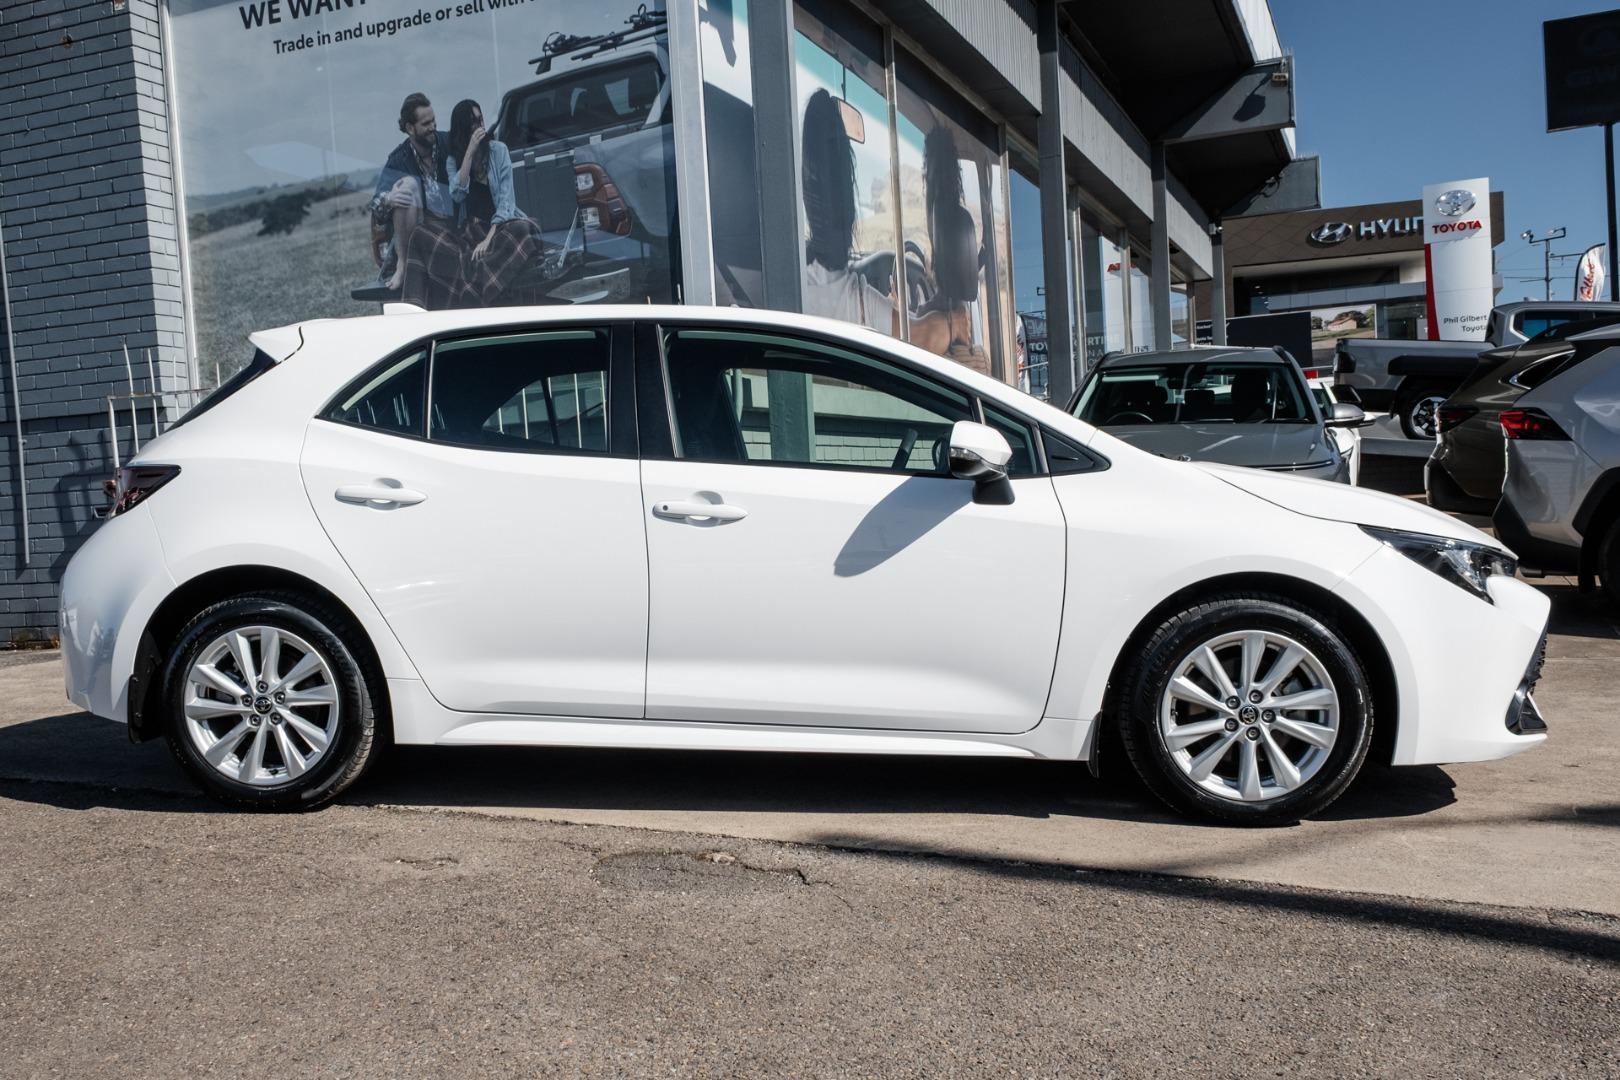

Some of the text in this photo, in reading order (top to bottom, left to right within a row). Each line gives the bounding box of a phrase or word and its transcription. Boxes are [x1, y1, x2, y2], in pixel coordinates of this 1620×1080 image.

[239, 0, 366, 30] WE WA
[273, 34, 314, 54] Trade
[317, 31, 331, 46] in
[334, 21, 363, 42] and
[366, 9, 432, 38] upgrade
[435, 7, 452, 21] or
[455, 0, 485, 17] sell
[1432, 220, 1482, 234] TOYOTA
[1443, 314, 1488, 324] Phil Gilbert
